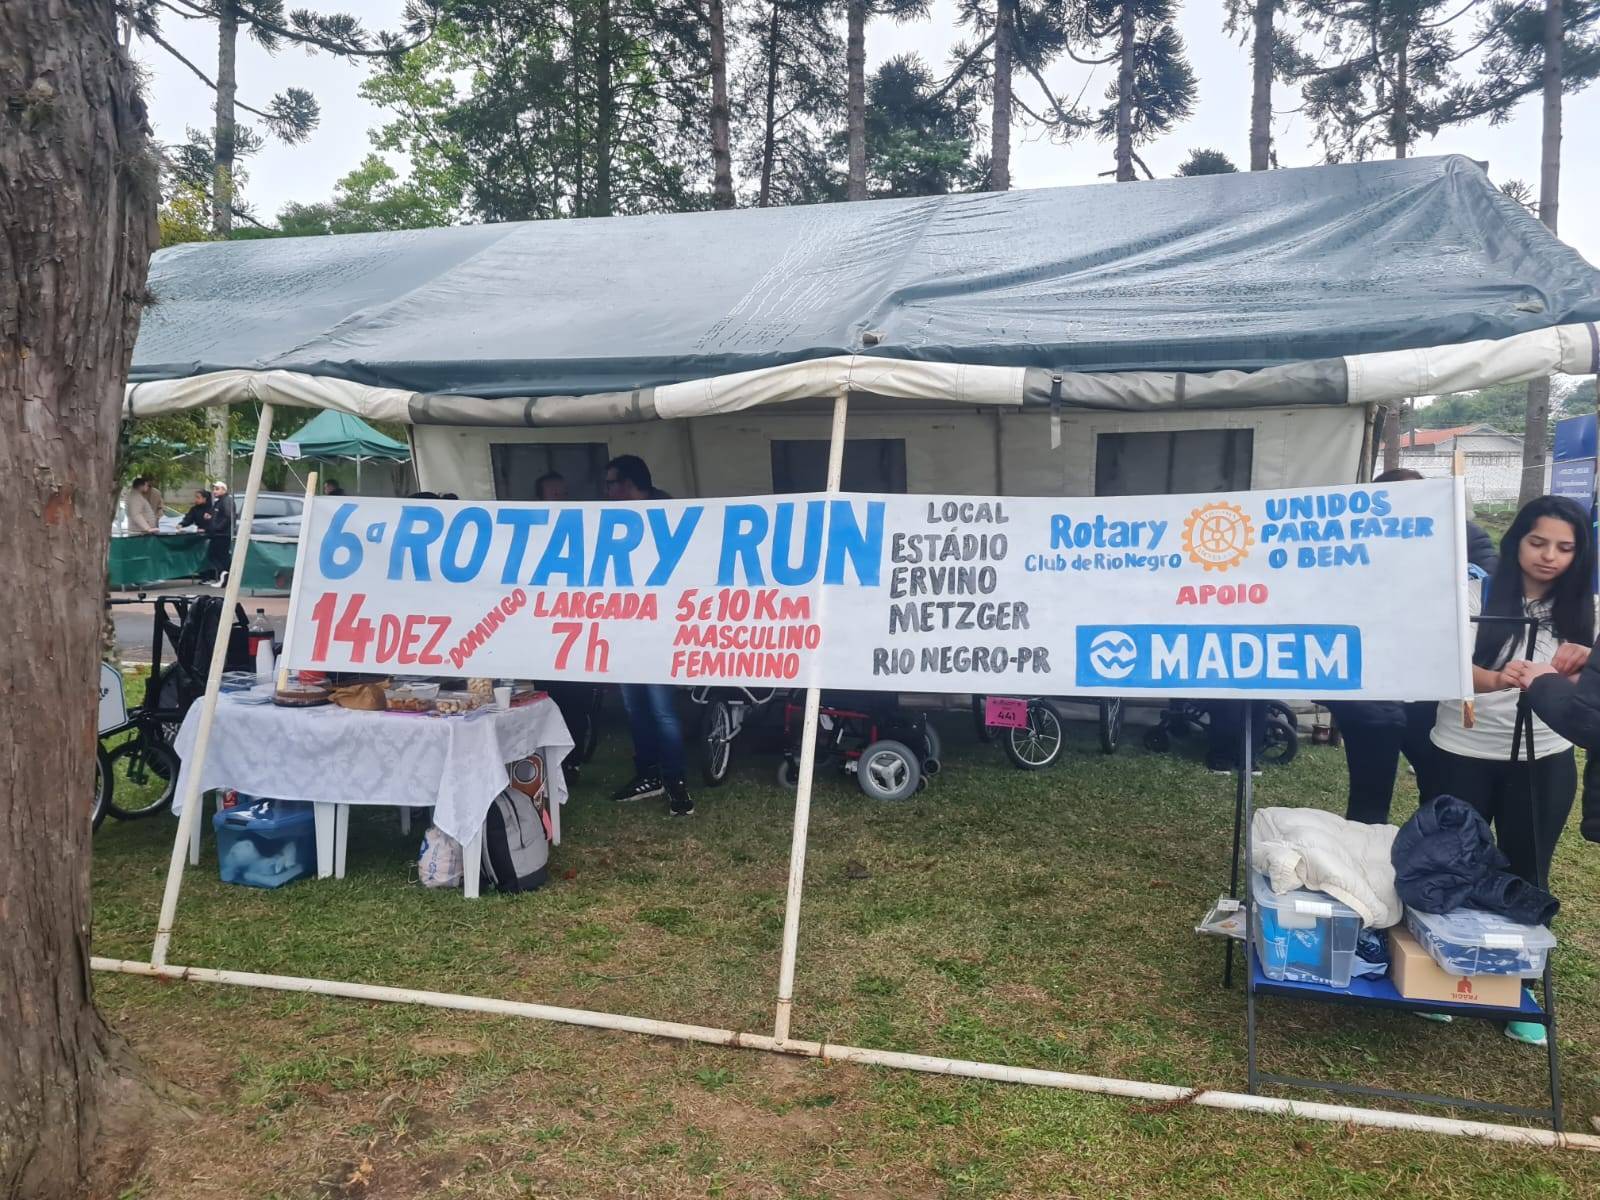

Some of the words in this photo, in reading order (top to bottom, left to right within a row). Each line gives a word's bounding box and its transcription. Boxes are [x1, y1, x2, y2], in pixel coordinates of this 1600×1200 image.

[927, 501, 1009, 525] LOCAL
[1265, 490, 1392, 521] UNIDOS
[387, 505, 704, 587] ROTARY
[717, 500, 886, 587] RUN
[1050, 514, 1168, 550] Rotary
[1261, 519, 1345, 543] PARA
[1351, 516, 1434, 540] FAZER
[891, 526, 1008, 564] ESTÁDIO
[1268, 548, 1288, 569] O
[1298, 543, 1371, 568] BEM
[1025, 554, 1067, 572] Club
[890, 566, 997, 599] ERVINO
[1176, 583, 1269, 606] APOIO
[534, 591, 658, 620] LARGADA
[675, 588, 699, 622] 5
[717, 588, 750, 622] 10
[889, 602, 1030, 635] METZGER
[311, 592, 375, 663] 14
[449, 588, 527, 669] DOMINGO
[673, 624, 821, 650] MASCULINO
[670, 651, 800, 679] FEMININO
[873, 647, 915, 676] RIO
[920, 646, 1051, 674] NEGRO-PR
[1151, 633, 1348, 680] MADEM
[997, 711, 1016, 721] 441
